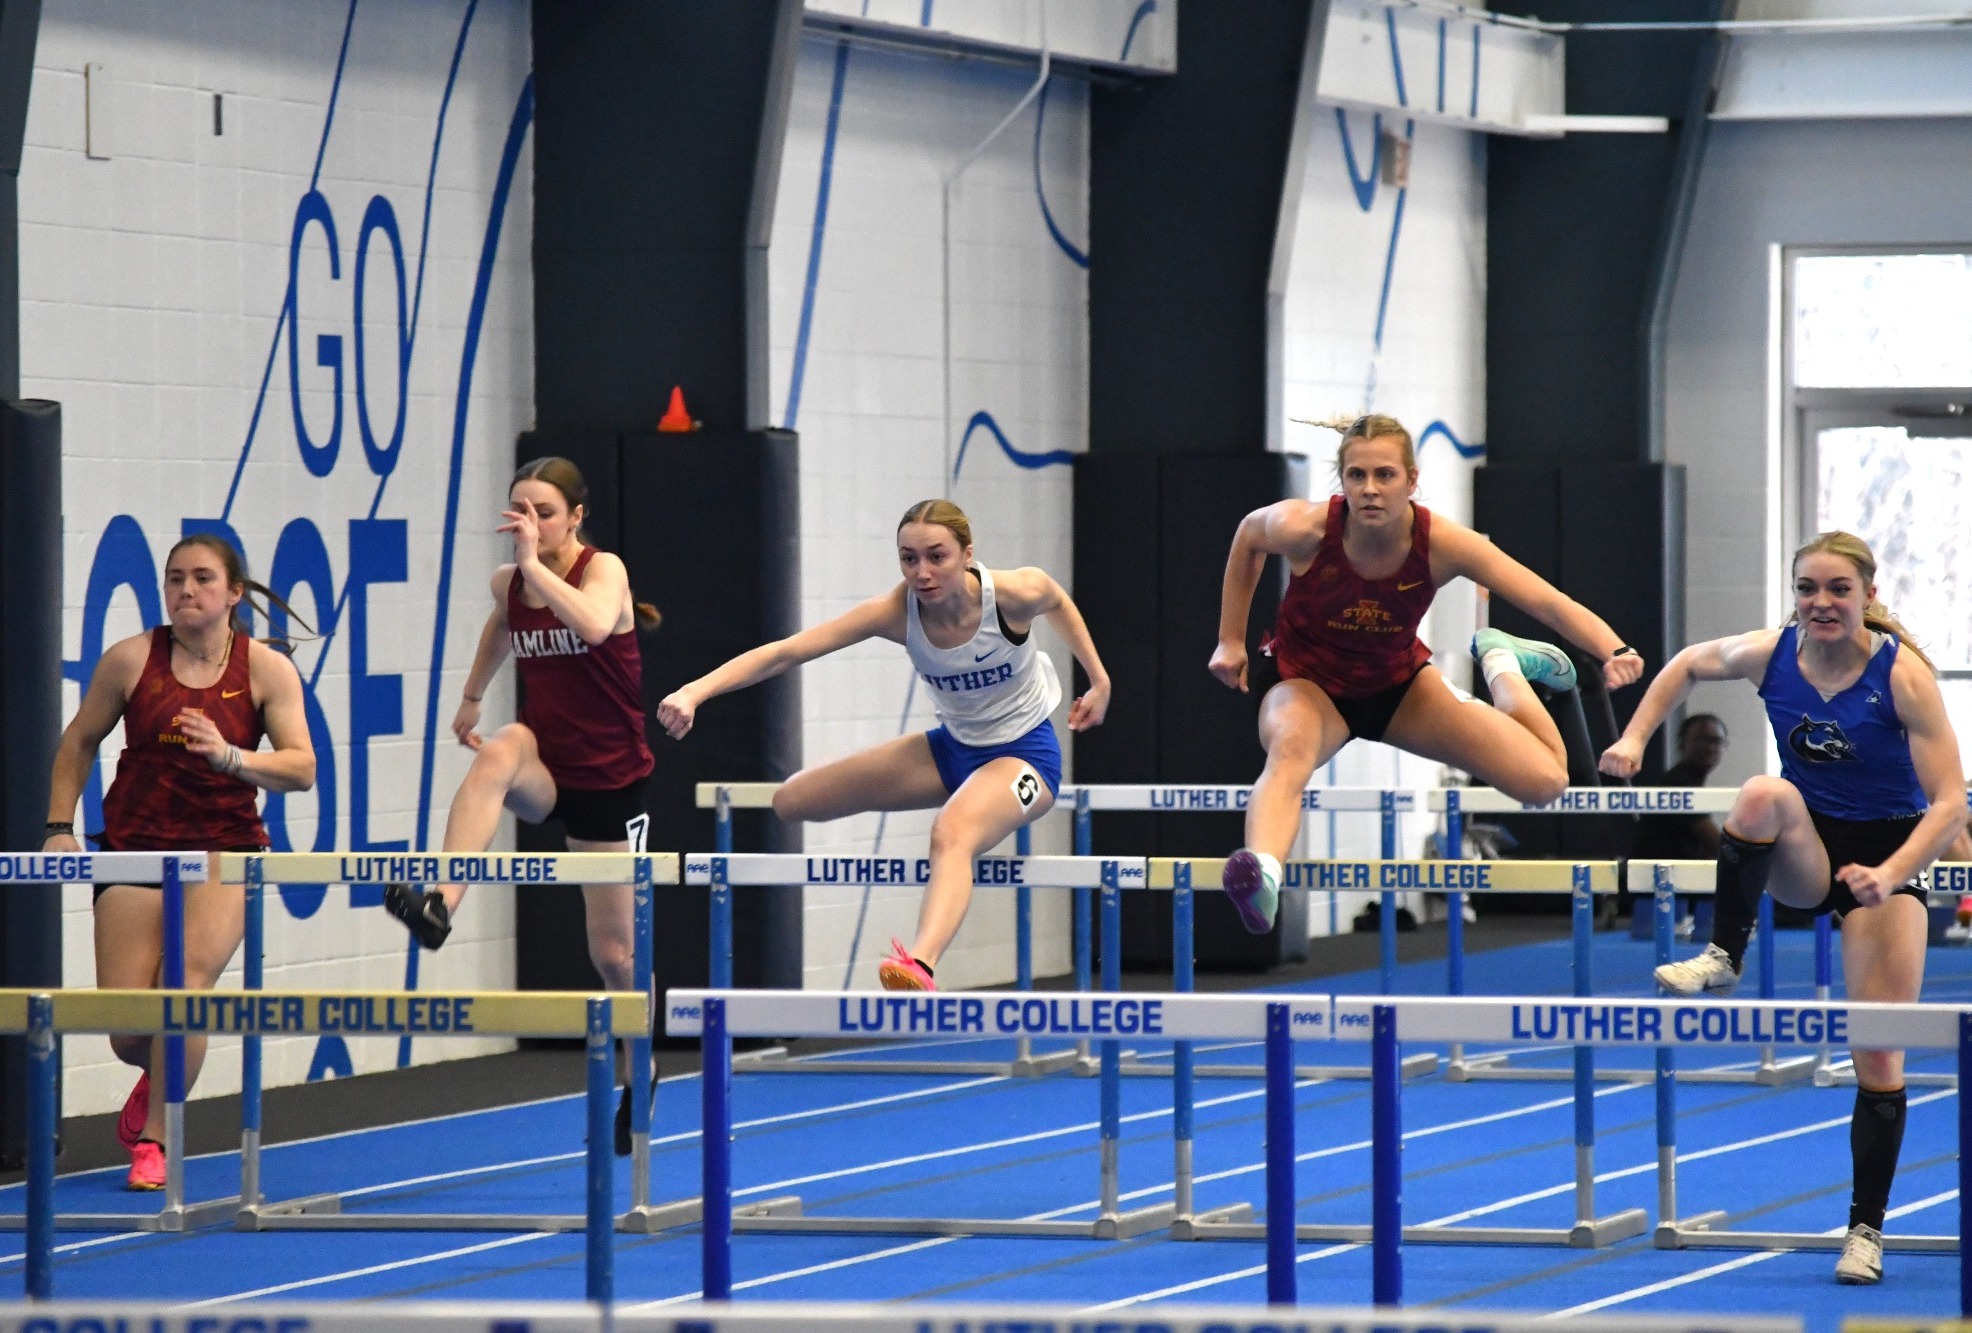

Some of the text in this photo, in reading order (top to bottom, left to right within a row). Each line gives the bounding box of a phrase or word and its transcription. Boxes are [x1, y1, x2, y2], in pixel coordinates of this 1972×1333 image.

[289, 190, 408, 477] GO
[1342, 607, 1391, 621] STATE
[513, 628, 589, 658] AMLINE
[924, 662, 1013, 692] UTHER
[1150, 789, 1228, 808] LUTHER
[1608, 791, 1695, 810] COLLEGE
[629, 817, 645, 853] 7
[0, 855, 93, 881] OLLEGE
[341, 857, 557, 882] LUTHER COLLEGE
[807, 858, 1024, 884] LUTHER CEGE
[1280, 863, 1491, 889] UTHER COLLEGE
[162, 996, 475, 1033] LUTHER COLLEGE
[838, 997, 1163, 1034] LUTHER COLLEGE
[1511, 1004, 1849, 1044] LUTHER COLLEGE
